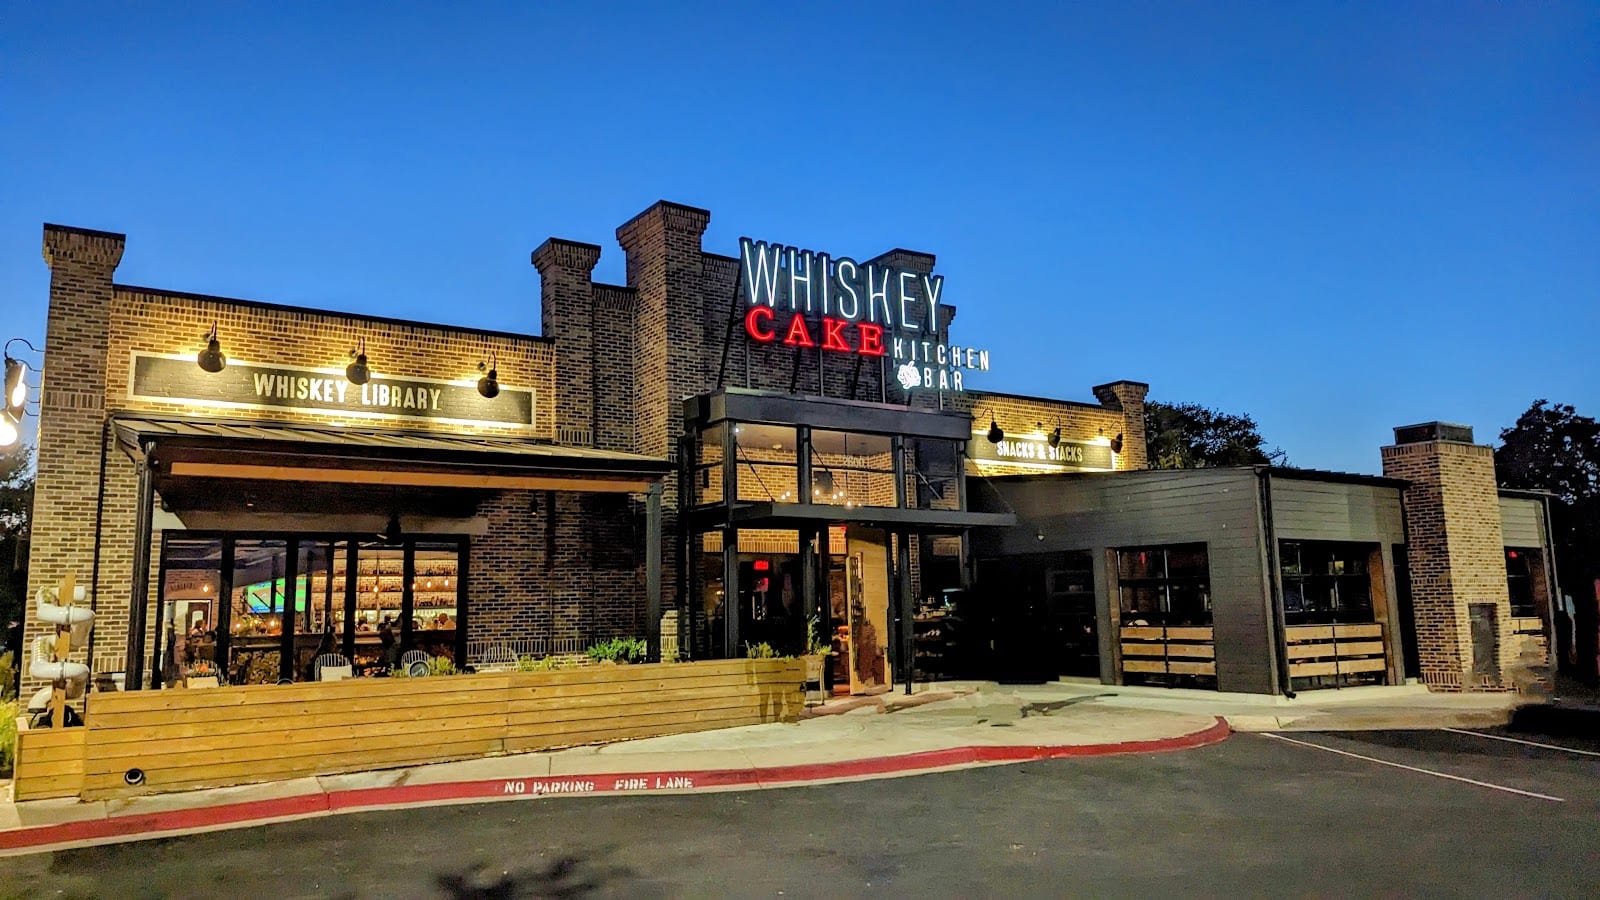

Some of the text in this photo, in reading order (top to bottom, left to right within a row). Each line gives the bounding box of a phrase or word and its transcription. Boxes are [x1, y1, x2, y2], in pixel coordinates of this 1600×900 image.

[742, 239, 943, 333] WHISKEY
[745, 304, 885, 356] CAKE
[893, 337, 990, 371] KITCHEN
[253, 372, 442, 411] WHISKEY LIBRARY
[923, 367, 964, 392] BAR
[996, 440, 1083, 462] SNACKS & STACKS
[504, 776, 695, 793] NO PARKING FIRE LANE
